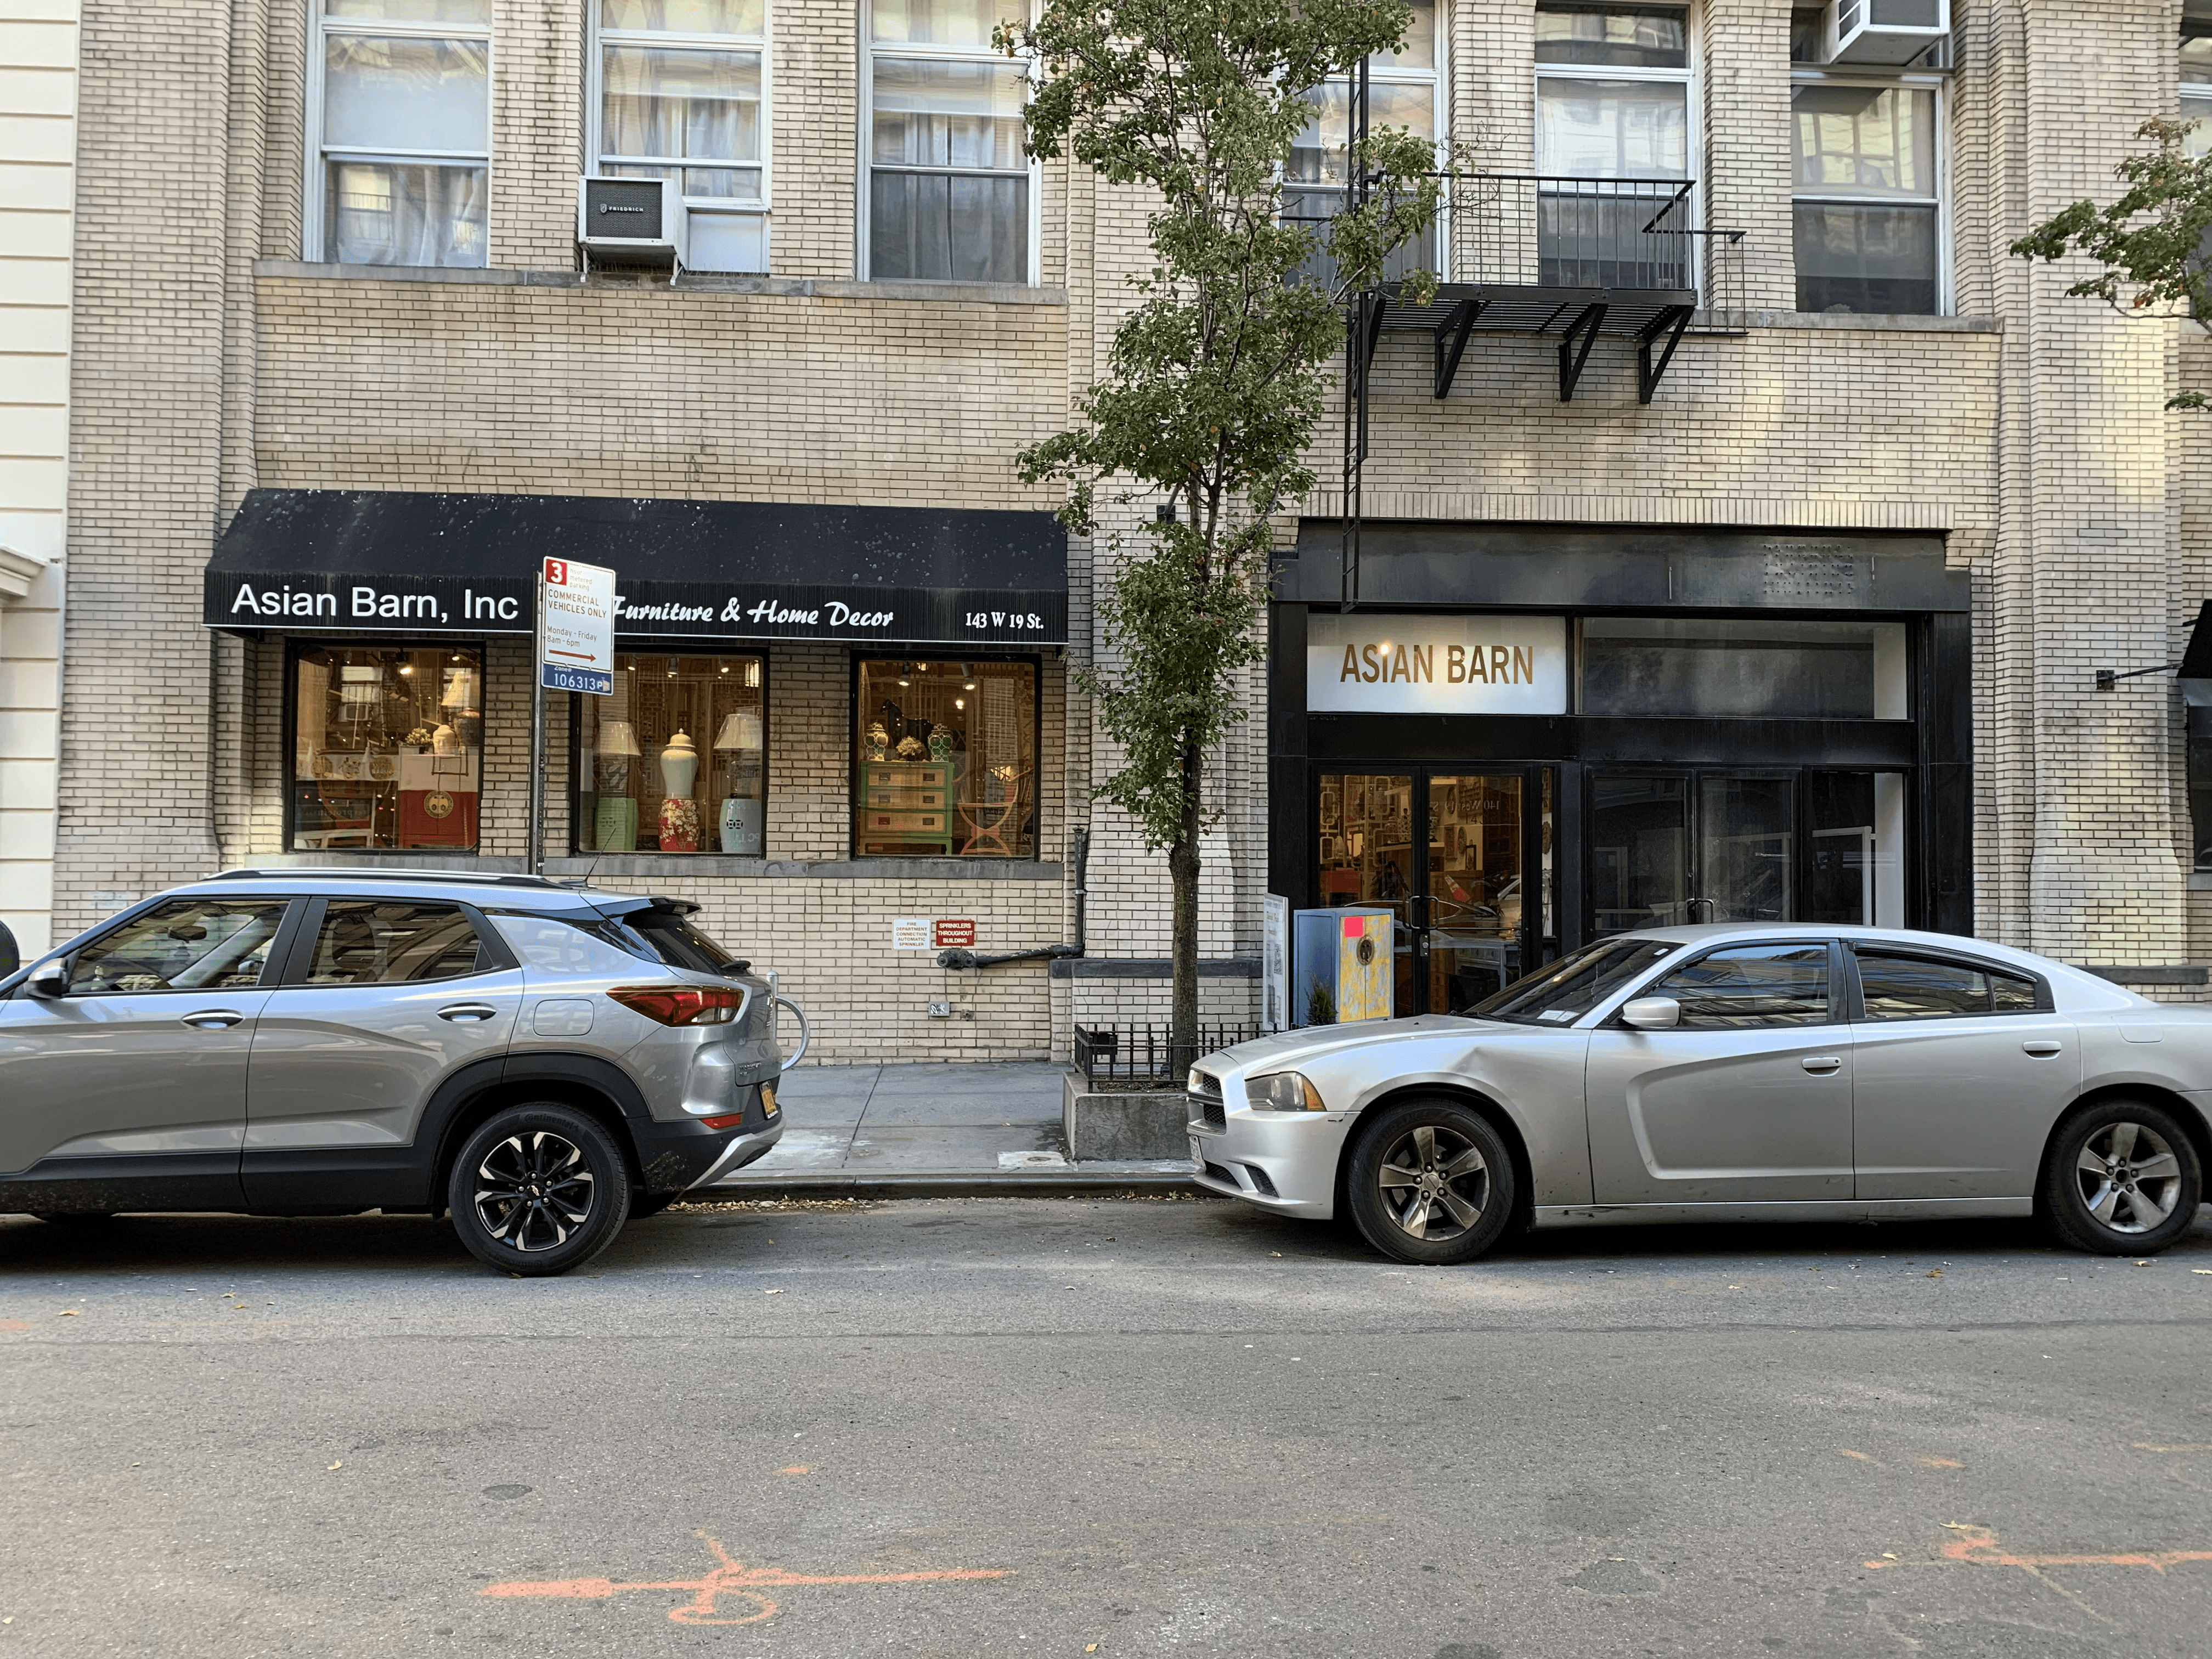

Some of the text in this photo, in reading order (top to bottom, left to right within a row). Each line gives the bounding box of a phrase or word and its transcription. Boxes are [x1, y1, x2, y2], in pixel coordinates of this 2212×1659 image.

[551, 562, 563, 583] 3
[569, 575, 592, 584] metered
[569, 582, 589, 591] parking
[231, 584, 518, 623] Asian Barn, Inc
[548, 589, 599, 606] COMMERCIAL
[548, 600, 607, 618] VEHICLES ONLY
[613, 595, 894, 627] Furniture & Home Decor
[966, 612, 1044, 629] 143 W 19 St.
[547, 626, 572, 637] Monday
[578, 631, 597, 642] Friday
[547, 635, 561, 644] 8am
[567, 639, 580, 648] 6pm
[1340, 644, 1533, 685] ASIAN BARN
[555, 673, 596, 691] 106313
[524, 1113, 574, 1130] Continental
